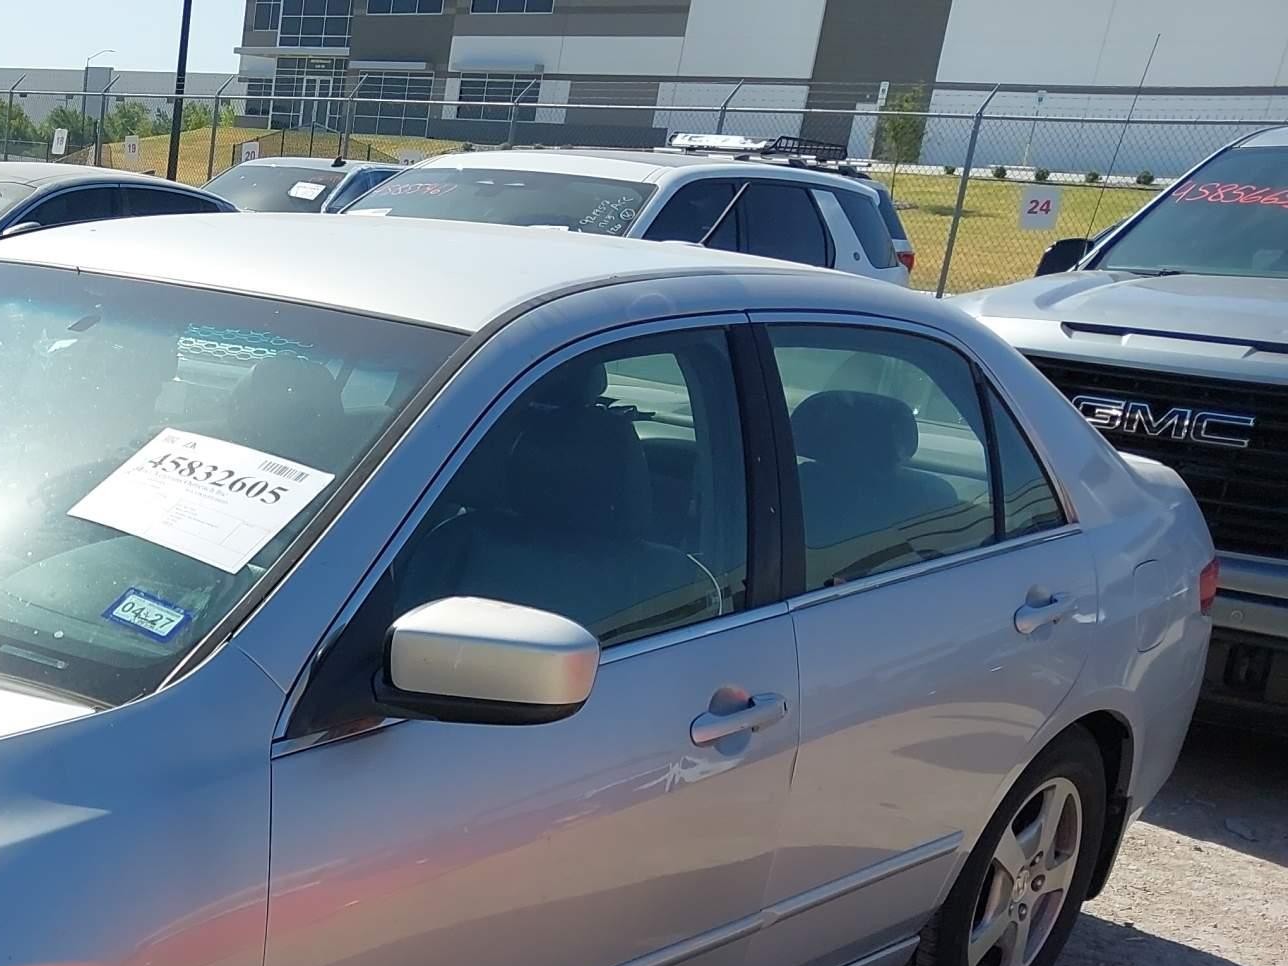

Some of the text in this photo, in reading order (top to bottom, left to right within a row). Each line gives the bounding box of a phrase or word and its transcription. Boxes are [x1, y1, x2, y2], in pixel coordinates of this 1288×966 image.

[245, 150, 255, 161] 20
[1027, 199, 1051, 215] 24
[1072, 395, 1256, 448] GMC
[148, 453, 289, 505] 45832605
[121, 601, 146, 618] 04
[149, 613, 175, 629] 27
